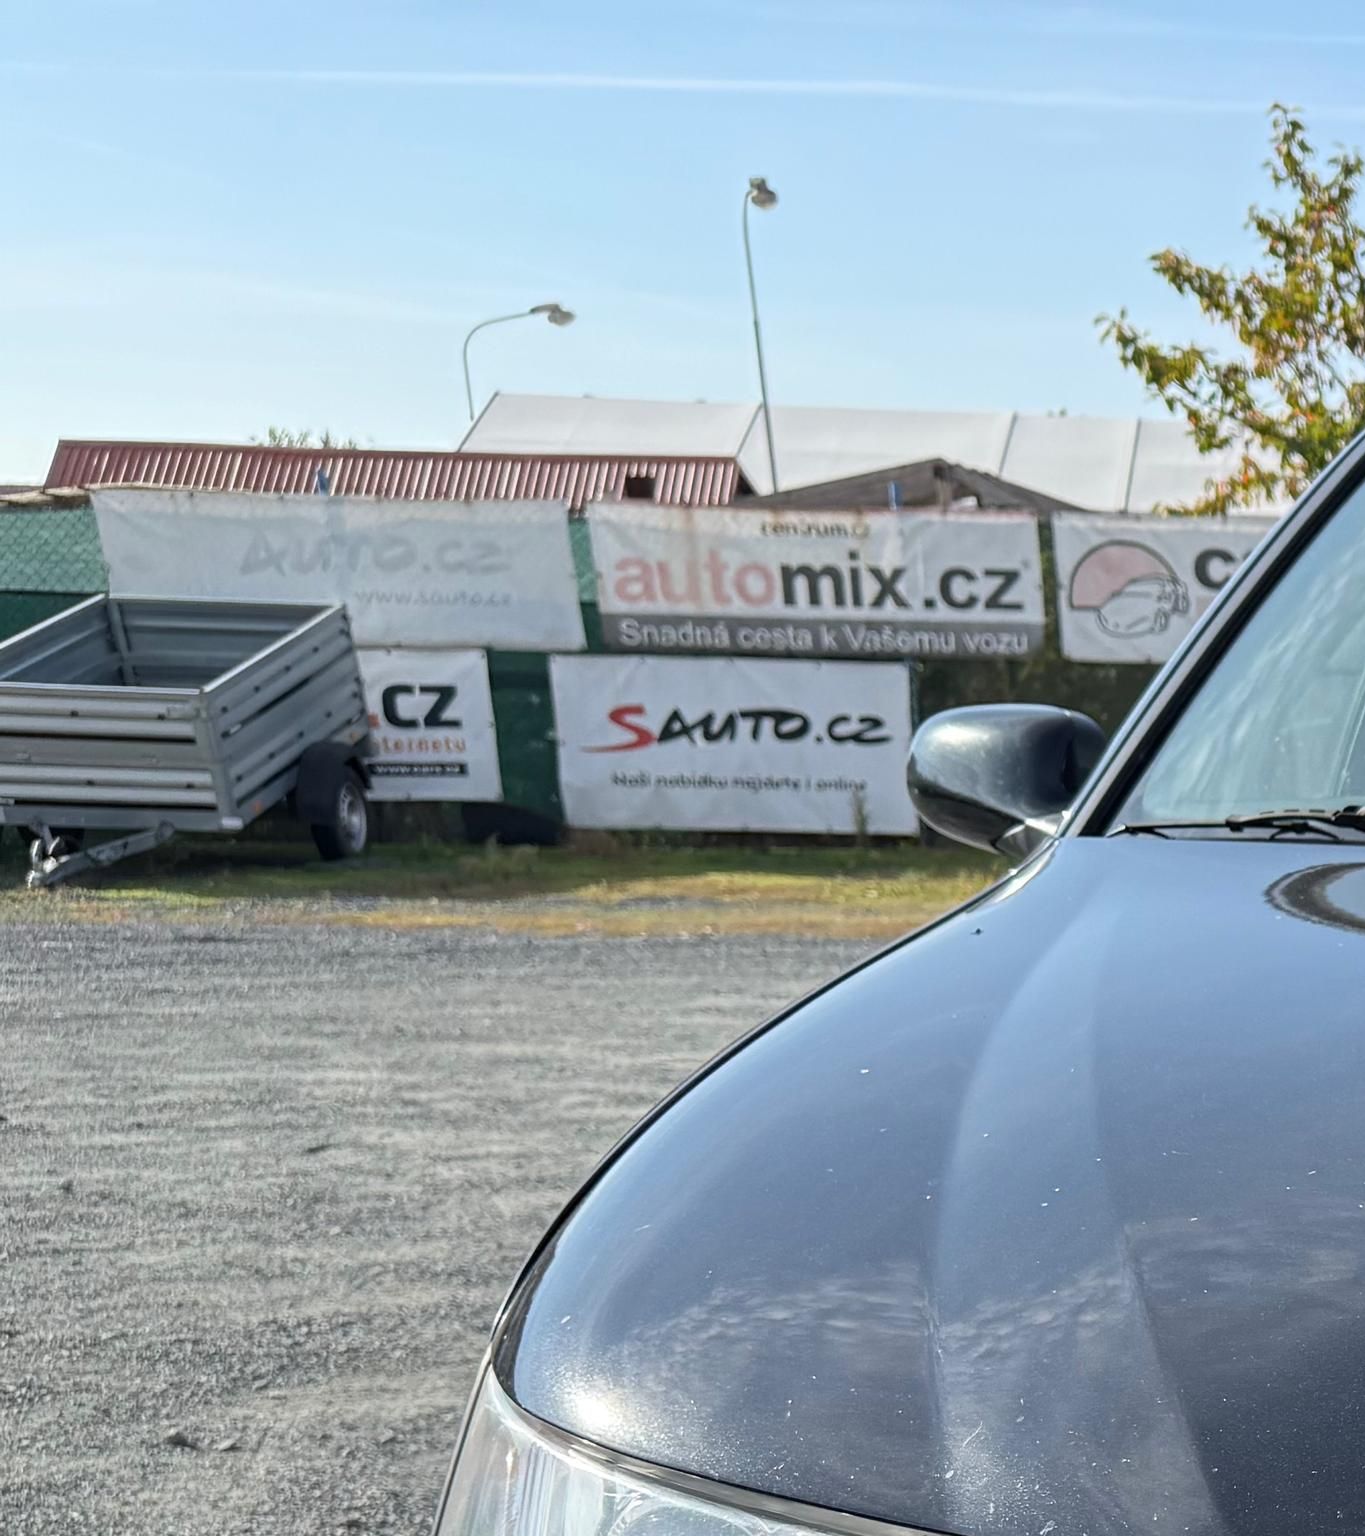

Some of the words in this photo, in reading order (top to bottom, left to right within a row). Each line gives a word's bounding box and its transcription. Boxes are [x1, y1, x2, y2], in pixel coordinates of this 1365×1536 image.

[613, 549, 1025, 611] automix.cz
[618, 617, 730, 649] Snadná
[736, 624, 814, 651] cesta
[819, 624, 839, 651] k
[841, 623, 956, 653] Vašemu
[962, 630, 1029, 654] vozu
